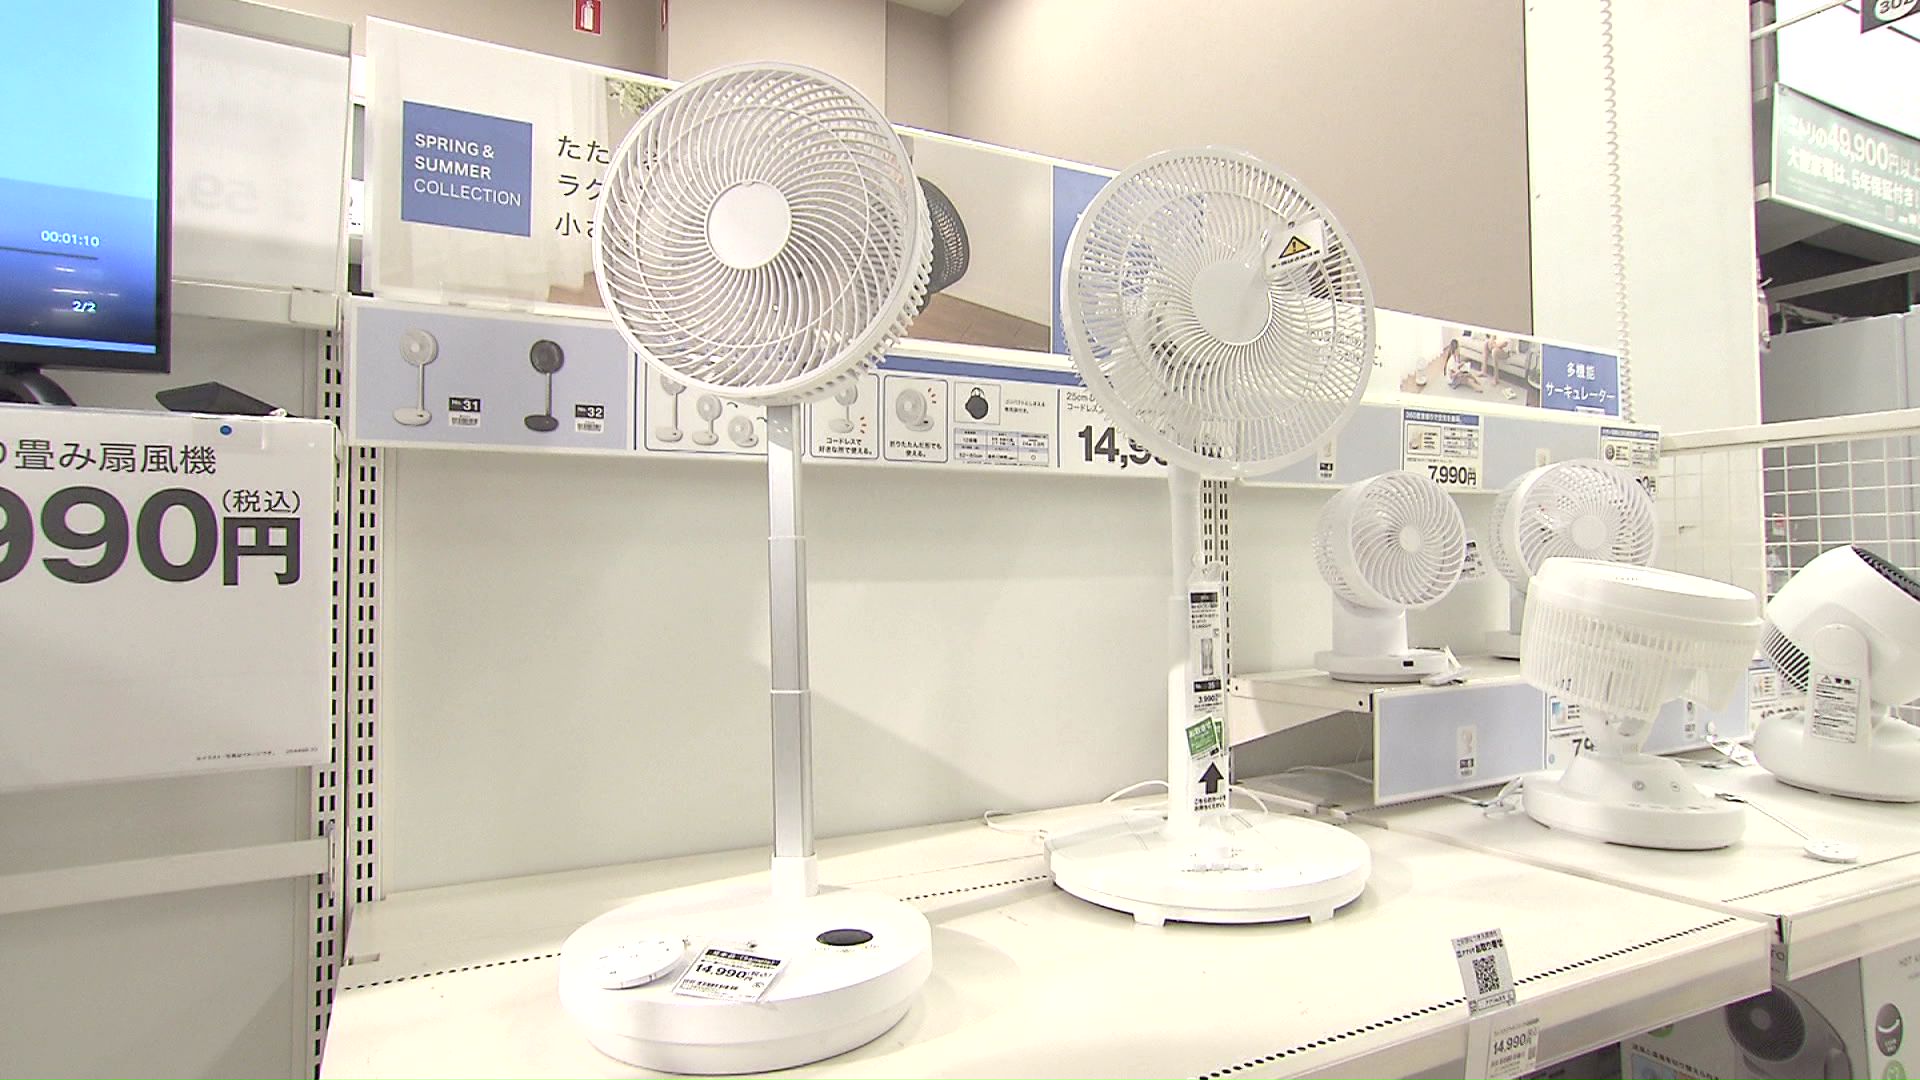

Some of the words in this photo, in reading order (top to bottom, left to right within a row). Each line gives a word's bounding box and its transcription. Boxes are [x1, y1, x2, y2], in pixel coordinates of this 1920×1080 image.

[415, 133, 479, 156] SPRING
[482, 145, 494, 159] &
[415, 156, 492, 180] SUMMER
[414, 179, 521, 207] COLLECTION
[41, 230, 100, 247] 00:01:10
[72, 300, 97, 314] 2/2
[1567, 362, 1595, 380] 多機能
[1546, 382, 1616, 403] サーキュレーター
[222, 488, 301, 515] (税込)
